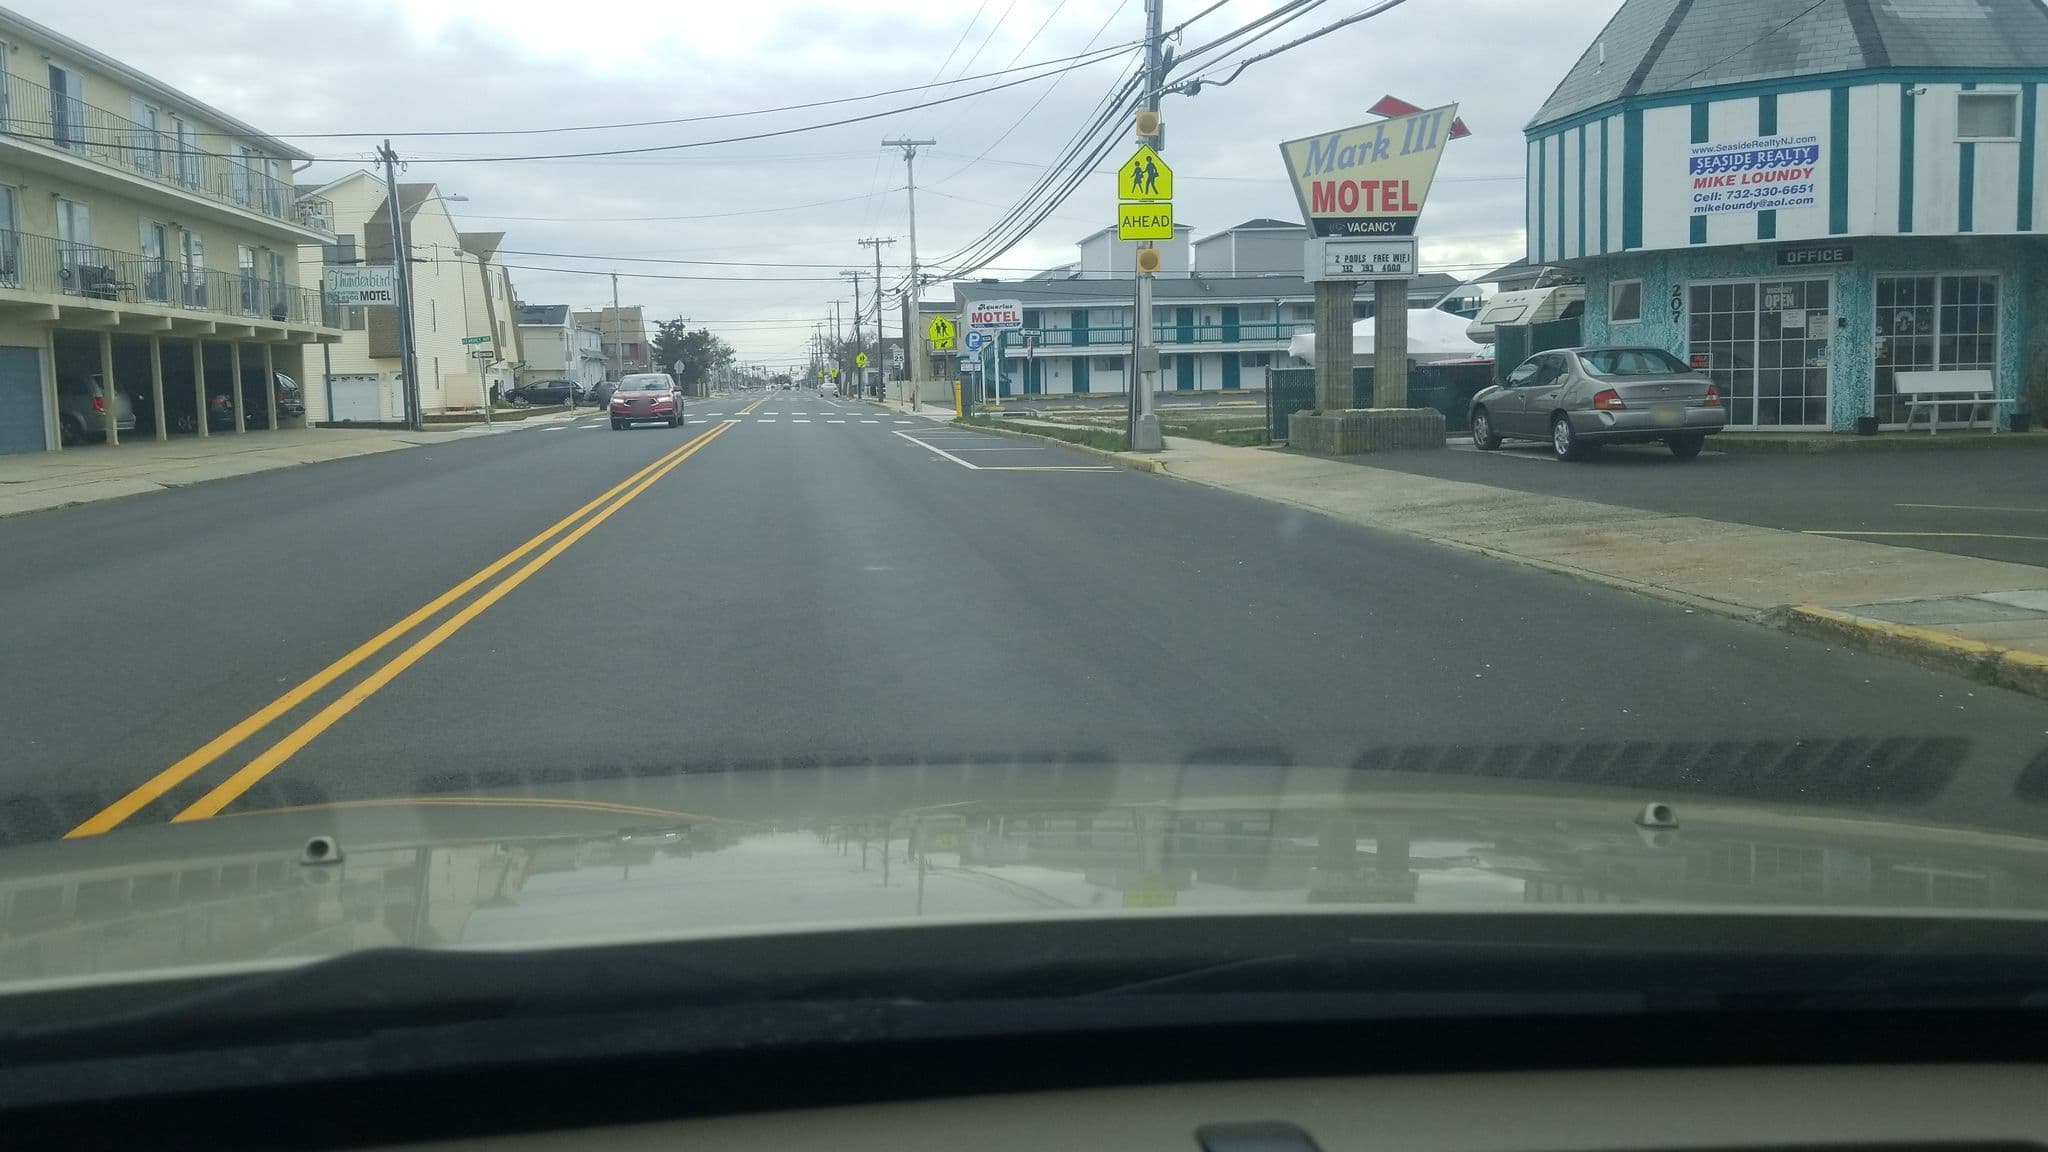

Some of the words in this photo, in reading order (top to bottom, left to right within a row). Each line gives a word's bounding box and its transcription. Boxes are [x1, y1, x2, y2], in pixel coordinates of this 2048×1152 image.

[1302, 125, 1391, 178] Mark
[1399, 111, 1443, 156] III
[1691, 135, 1817, 154] www.SeasideRealtyNJ.com
[1696, 152, 1752, 169] SEASIDE
[1757, 147, 1811, 163] REALTY
[1693, 174, 1737, 189] MIKE
[1741, 167, 1815, 185] LOUNDY
[1312, 179, 1418, 213] MOTEL
[1693, 192, 1722, 203] Cell:
[1726, 184, 1814, 201] 732-330-6651
[1693, 196, 1814, 213] mikeloundy@aol.com
[1122, 215, 1170, 228] AHEAD
[1347, 221, 1397, 233] VACANCY
[1335, 254, 1340, 263] 2
[1344, 254, 1366, 263] POOLS
[1373, 254, 1389, 263] FREE
[1787, 248, 1843, 263] OFFICE
[327, 269, 391, 291] Thunderbird
[359, 290, 392, 301] MOTEL
[1671, 284, 1682, 323] 207
[1765, 293, 1794, 308] OPEN
[971, 311, 1020, 323] MOTEL
